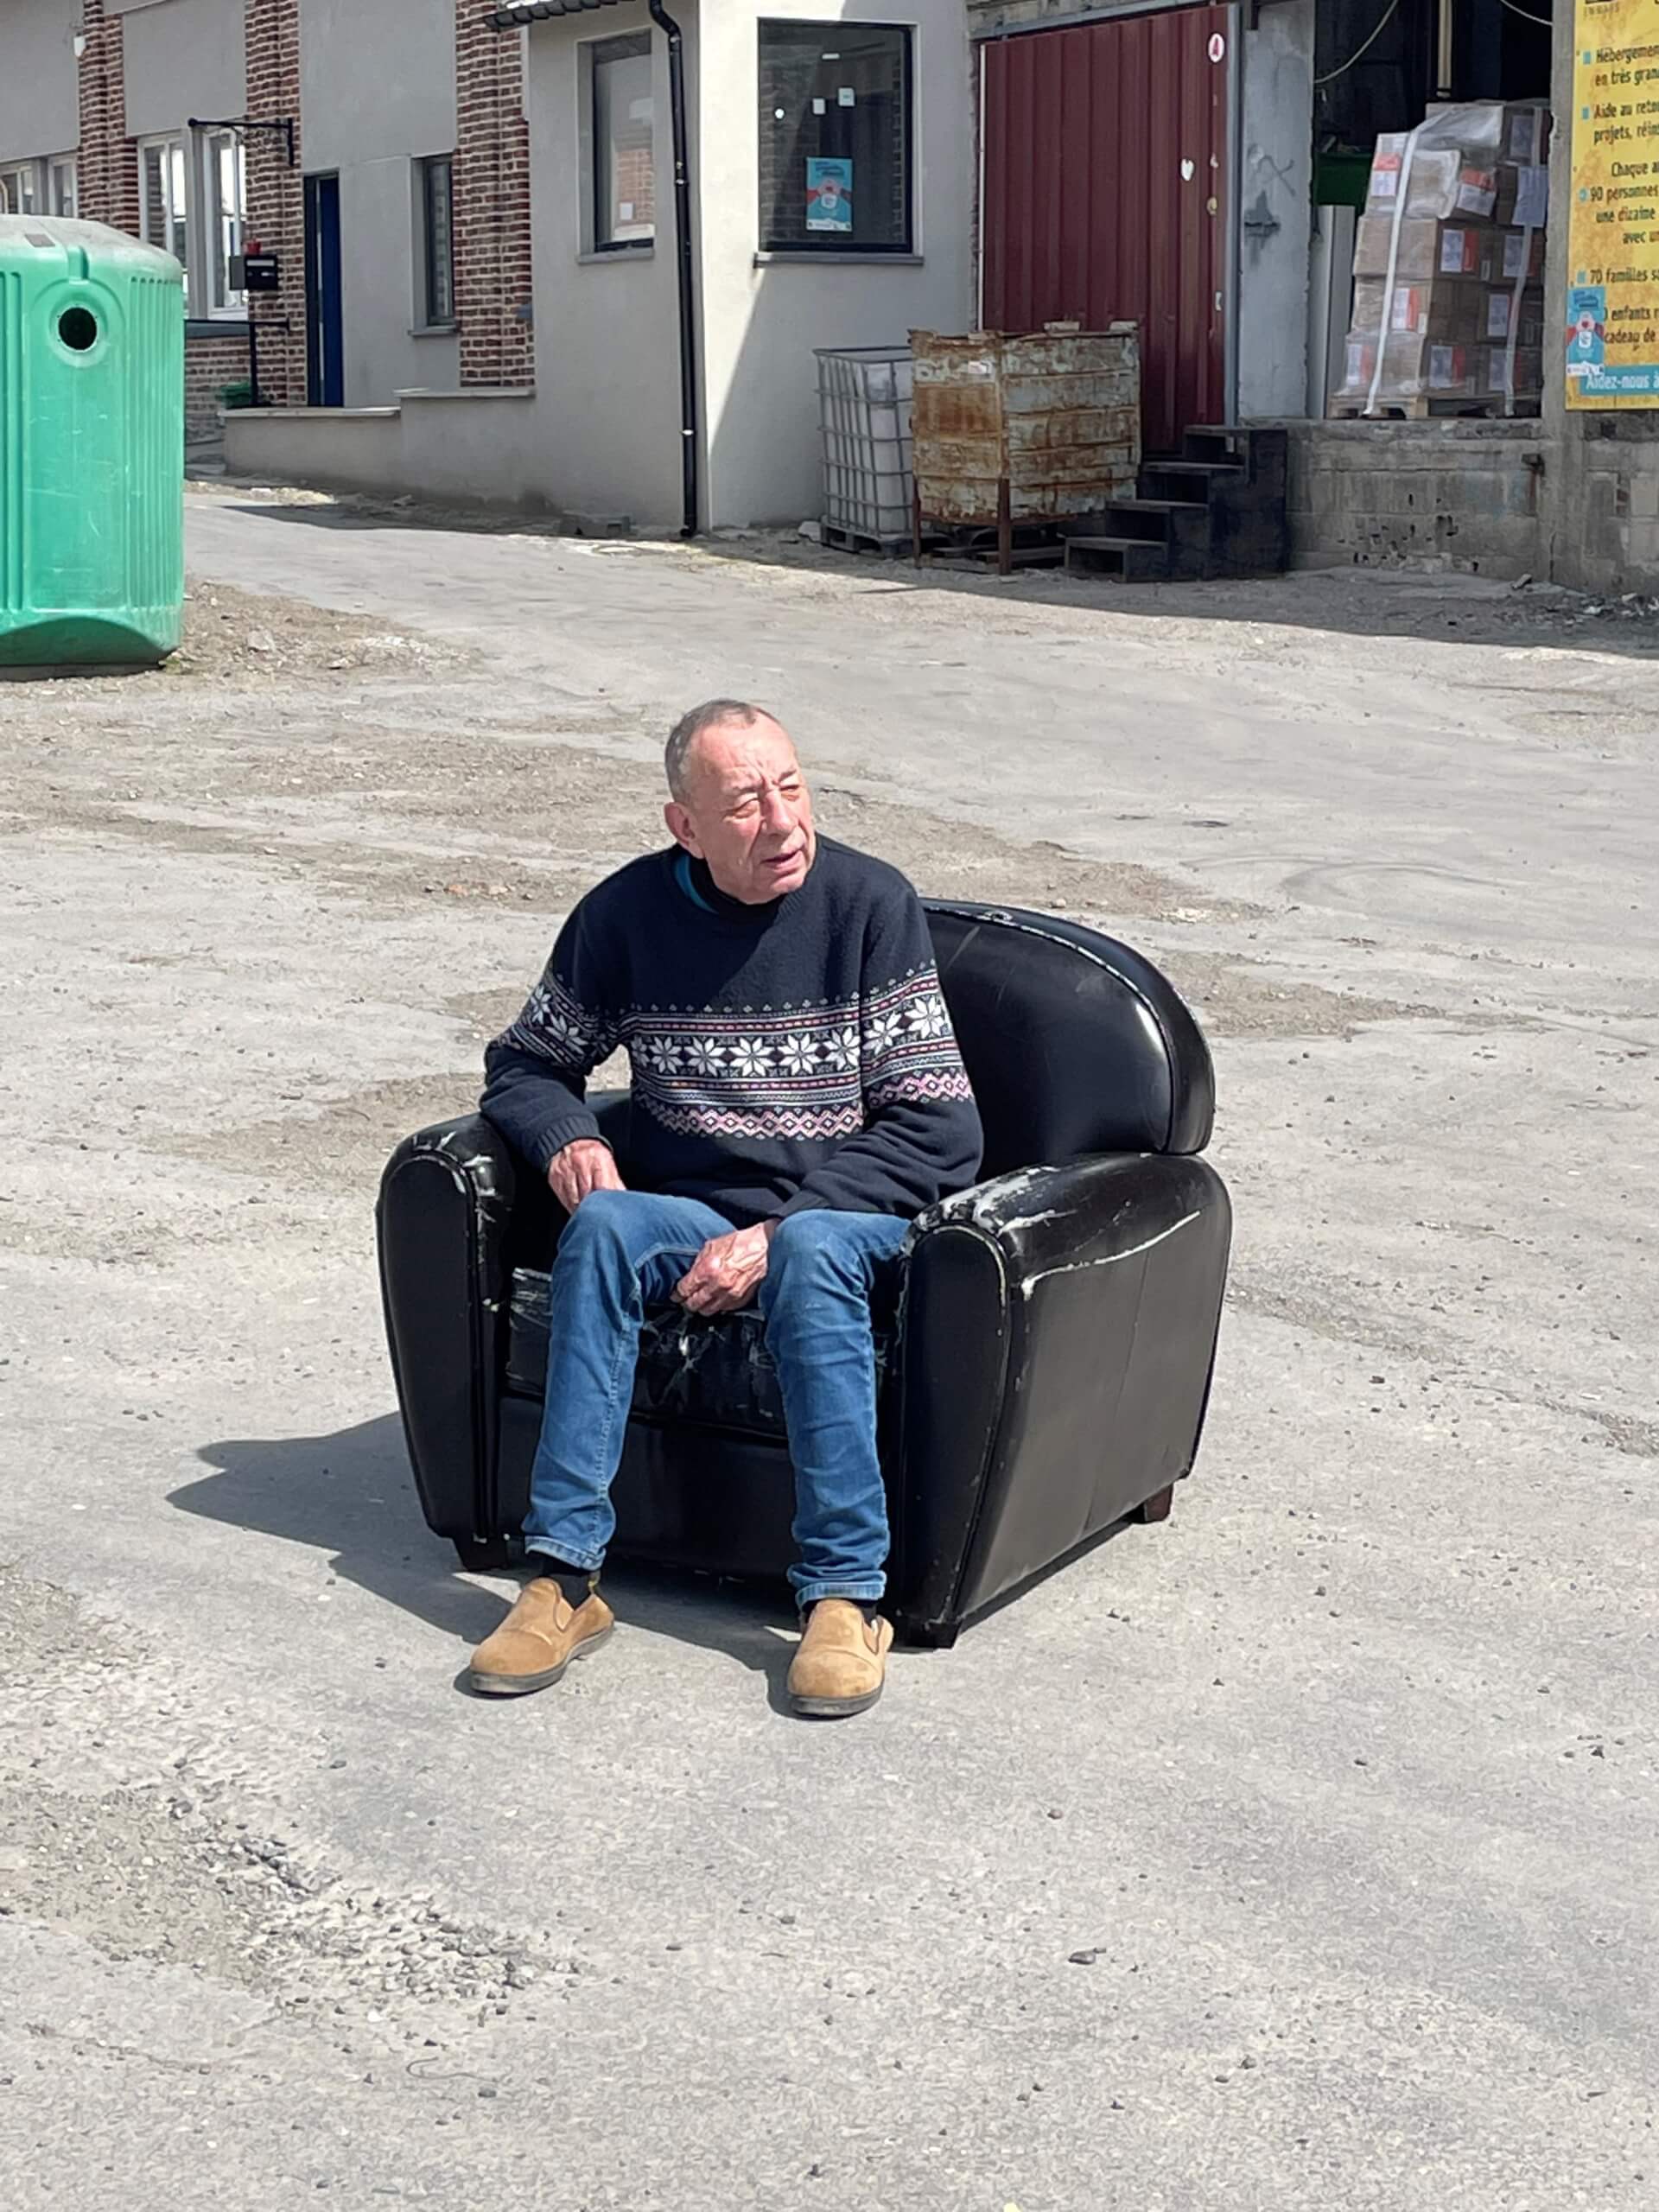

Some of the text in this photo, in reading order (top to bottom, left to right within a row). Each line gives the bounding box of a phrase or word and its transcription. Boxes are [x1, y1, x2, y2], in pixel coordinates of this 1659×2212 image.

[1595, 68, 1659, 86] en très gran
[1593, 103, 1617, 119] Aide
[1620, 105, 1632, 117] au
[1593, 125, 1632, 145] projets,
[1611, 162, 1649, 178] Chaque
[1590, 184, 1658, 204] 90 personnes
[1596, 206, 1656, 223] une dizaine
[1623, 231, 1646, 245] avec
[1590, 269, 1603, 284] 70
[1605, 268, 1648, 283] familles
[1611, 305, 1650, 321] enfants
[1605, 327, 1656, 344] cadeau de
[1586, 372, 1649, 390] Aidez-nous
